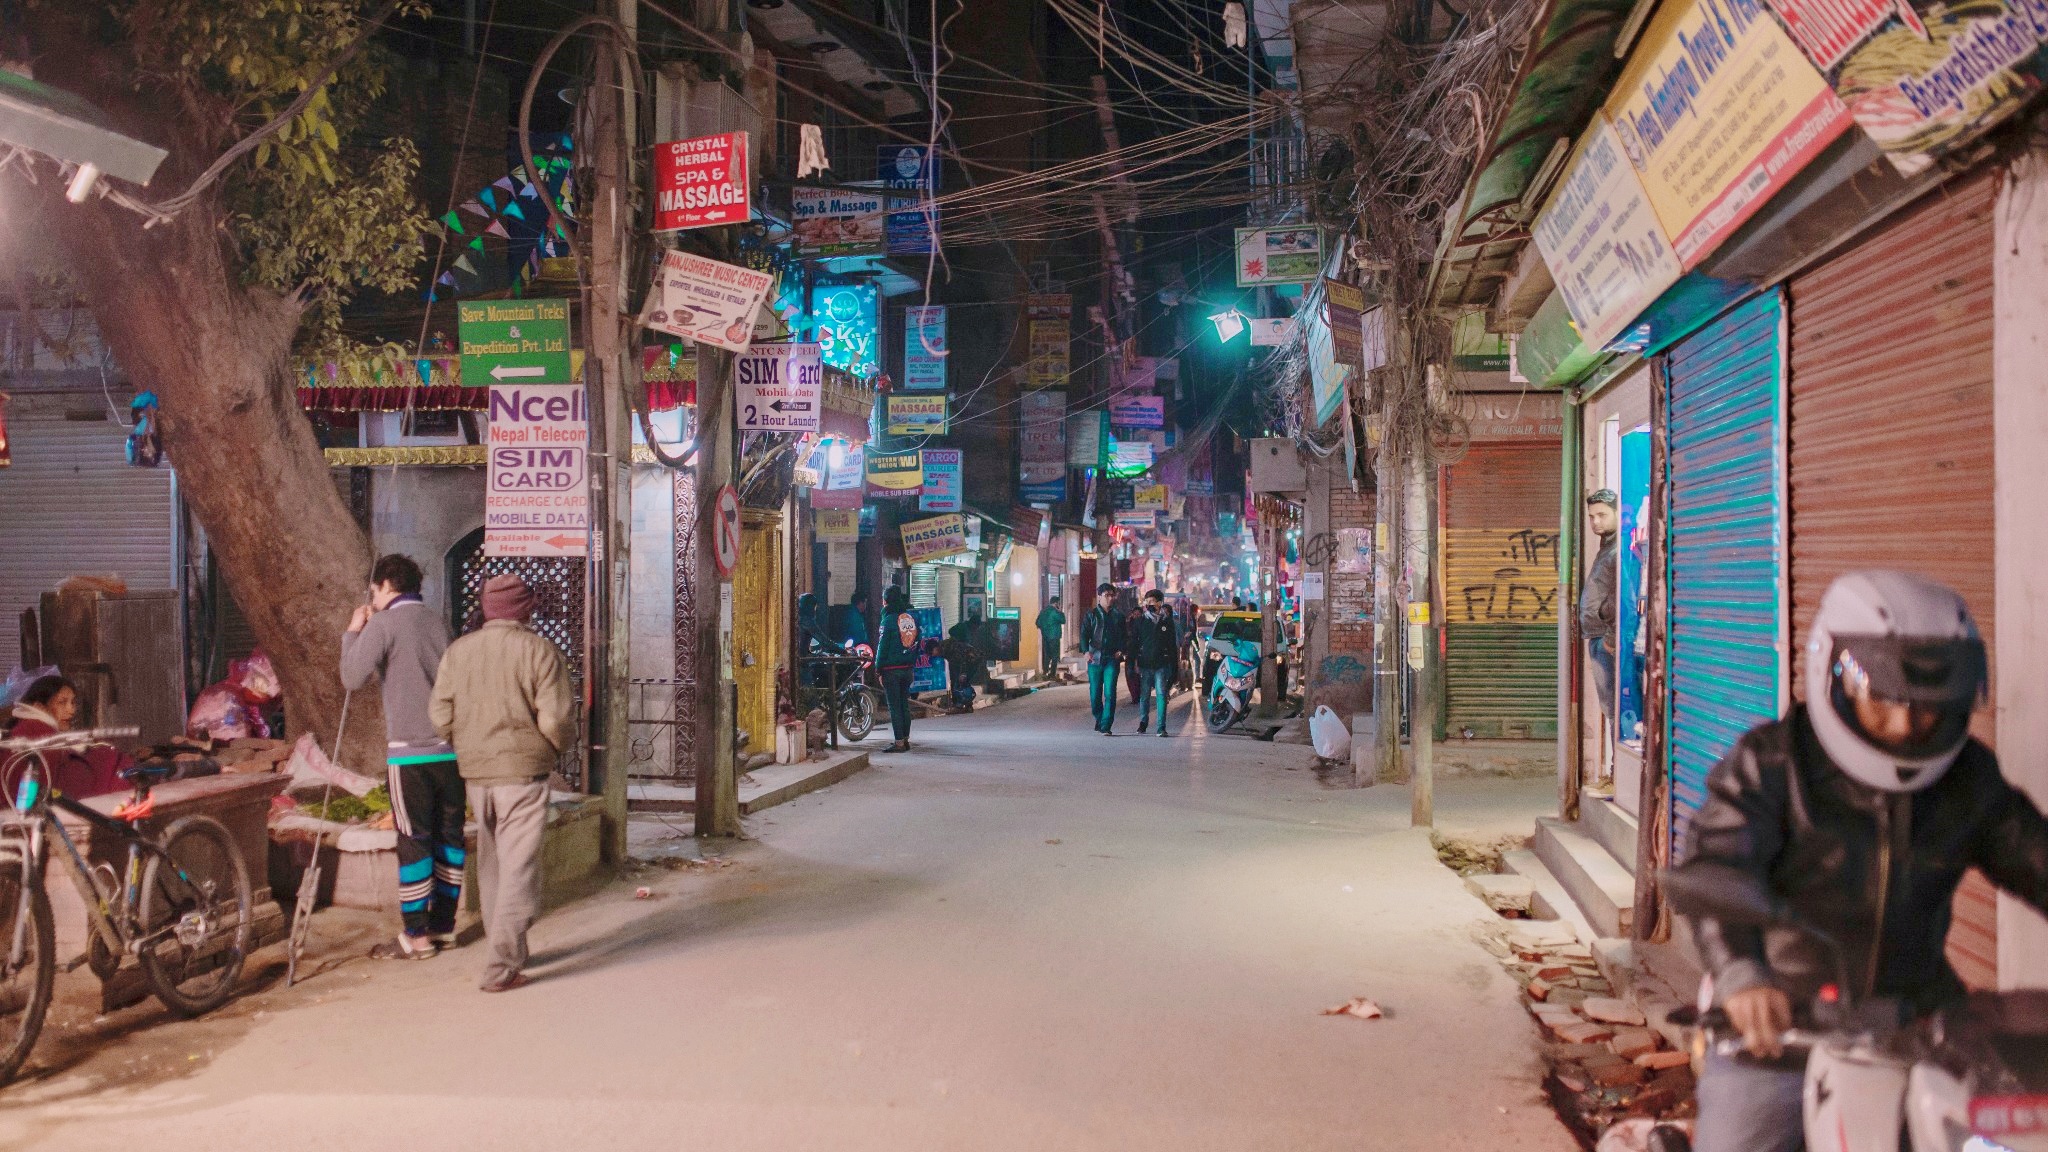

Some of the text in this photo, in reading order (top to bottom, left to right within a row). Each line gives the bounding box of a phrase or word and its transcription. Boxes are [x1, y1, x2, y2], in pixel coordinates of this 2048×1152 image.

[1677, 0, 1728, 84] Travel
[671, 137, 729, 155] CRYSTAL
[675, 150, 725, 166] HERBAL
[675, 167, 724, 185] SPA &
[659, 182, 745, 212] MASSAGE
[794, 189, 827, 200] Perfect
[795, 201, 815, 216] Spa
[817, 199, 827, 214] &
[829, 199, 878, 214] Massage
[686, 213, 701, 221] Floor
[663, 252, 714, 279] MANJUSHREE
[713, 265, 736, 283] MUSIC
[737, 271, 769, 293] CENTER
[461, 302, 565, 323] Save Mountain Treks
[509, 325, 521, 339] &
[462, 337, 566, 359] Expedition Pvt. Ltd.
[750, 346, 775, 356] NTC
[777, 347, 785, 356] &
[738, 357, 821, 385] SIM Card
[755, 388, 814, 397] Mobile Data
[490, 388, 586, 422] Ncell
[890, 403, 943, 413] MASSAGE
[744, 404, 818, 429] 2 Hour Laundry
[490, 426, 529, 444] Nepal
[1027, 433, 1057, 442] TREK
[496, 449, 573, 468] SIM
[843, 454, 862, 468] CARD
[869, 457, 898, 465] WESTERN
[898, 455, 917, 467] WU
[922, 453, 957, 463] CARGO
[923, 464, 958, 472] COURIER
[497, 472, 571, 488] CARD
[870, 490, 889, 498] NOBLE
[890, 489, 901, 497] SUB
[902, 488, 919, 496] REMIT
[487, 496, 587, 507] RECHARGE CARD
[488, 513, 586, 524] MOBILE DATA
[903, 515, 958, 533] Unique Spa &
[486, 534, 541, 542] Available
[904, 524, 961, 544] MASSAGE
[499, 544, 527, 552] Here
